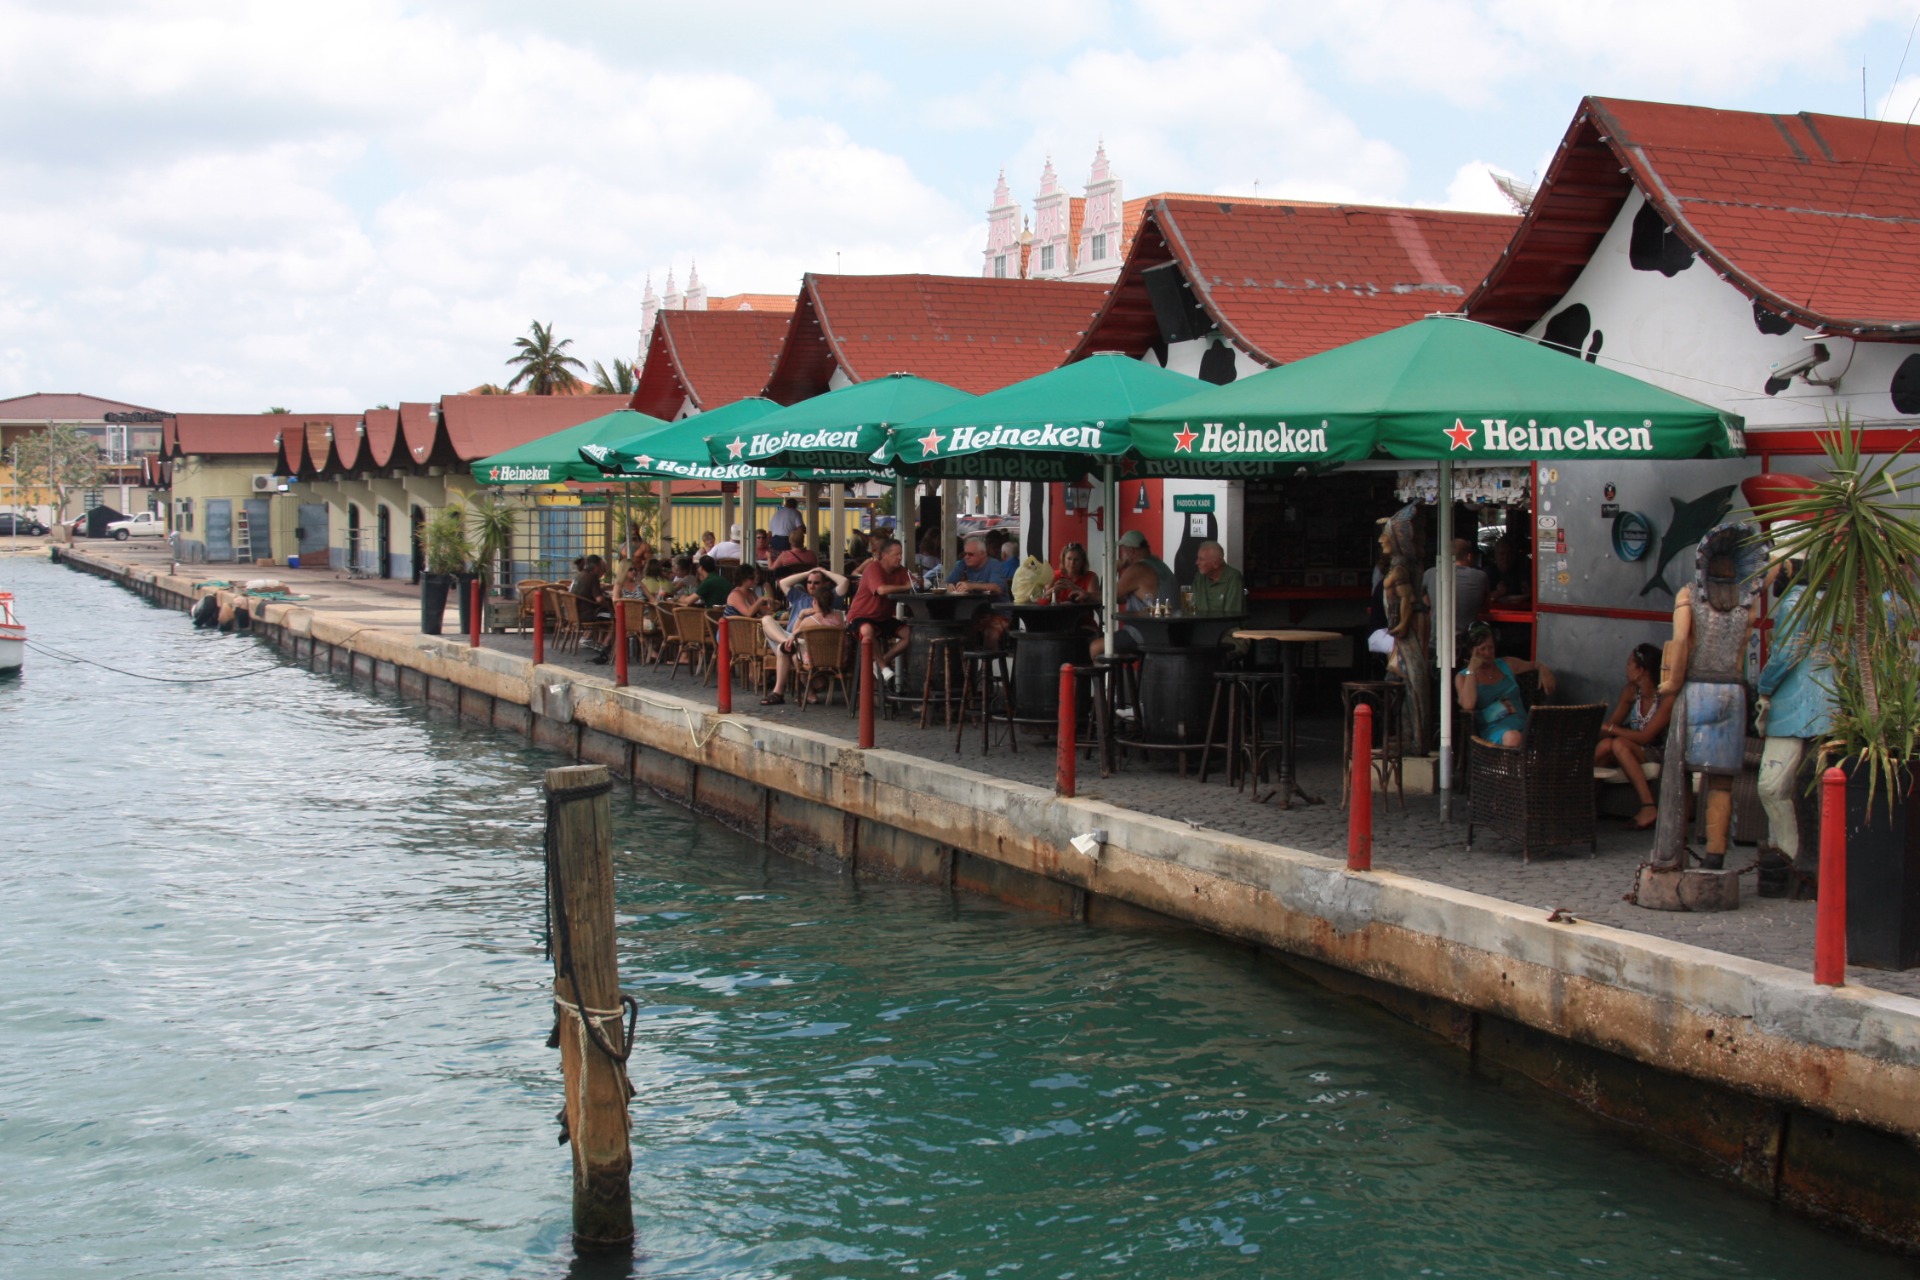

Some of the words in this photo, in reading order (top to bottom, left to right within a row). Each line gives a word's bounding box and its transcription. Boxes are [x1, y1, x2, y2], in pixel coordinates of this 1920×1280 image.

[748, 429, 858, 456] Heineken
[947, 424, 1101, 451] Heineken
[1200, 422, 1328, 452] Heineken
[1481, 419, 1653, 450] Heineken
[655, 460, 767, 479] Heineken
[789, 450, 870, 468] Heinek
[500, 465, 550, 480] Heineken
[1177, 499, 1197, 507] PADDOCK
